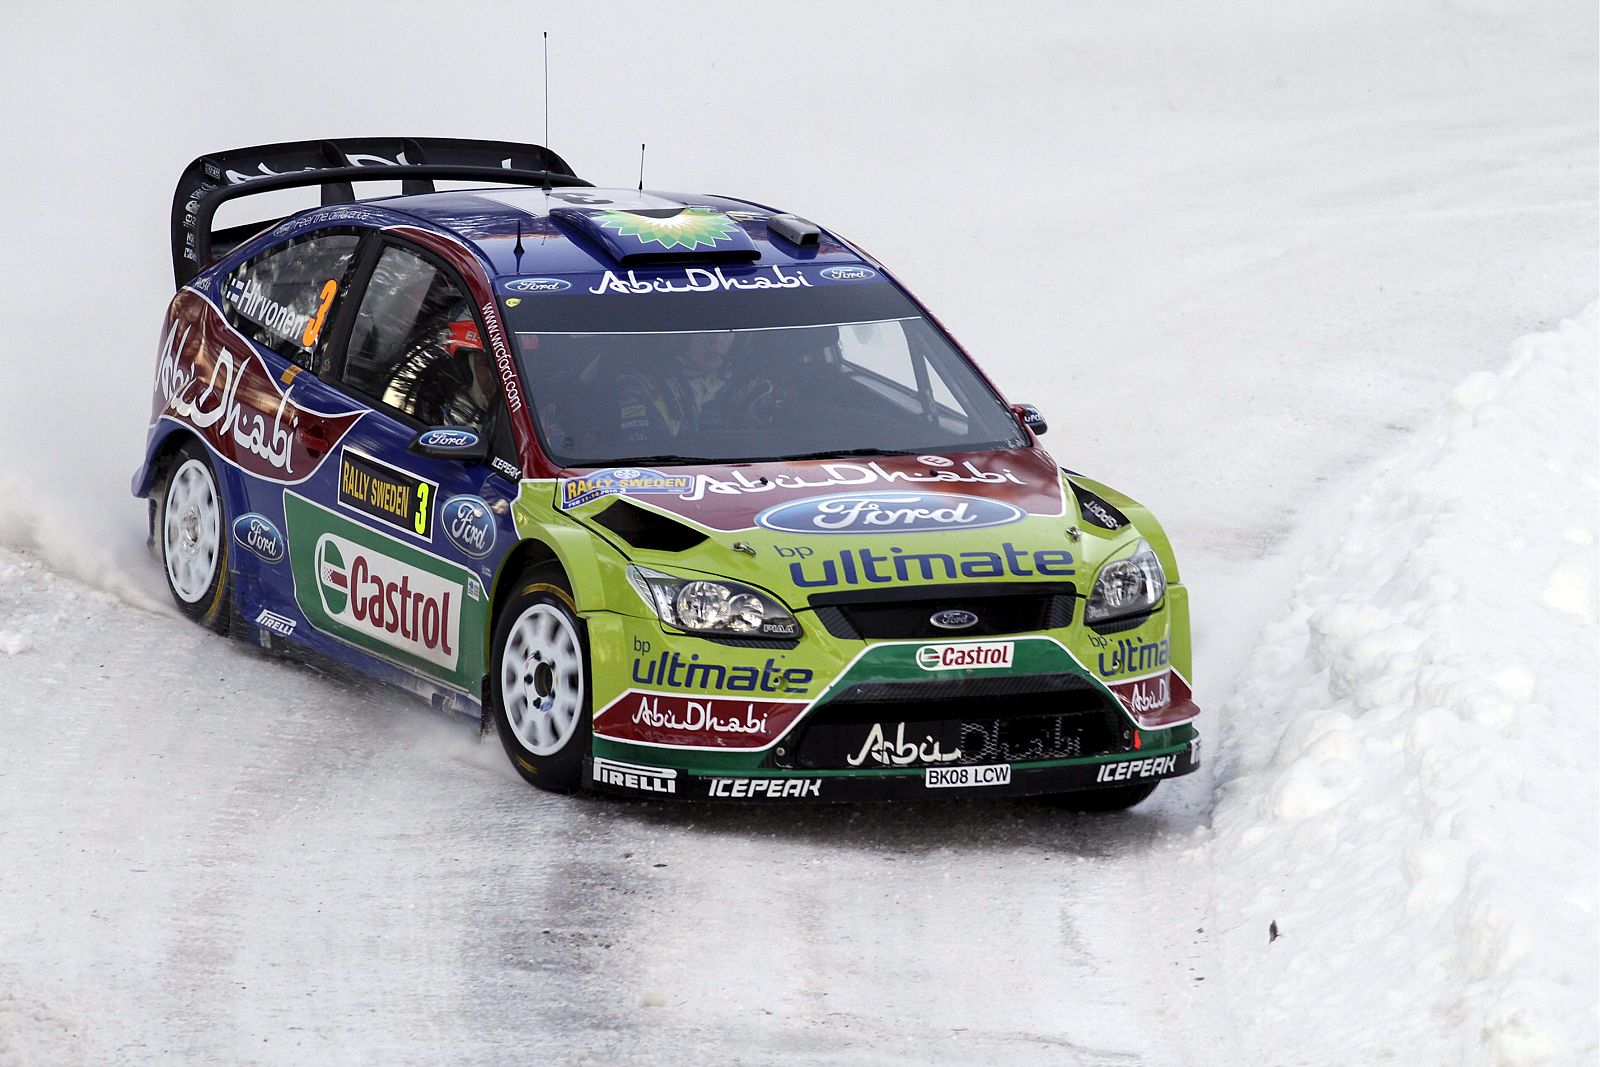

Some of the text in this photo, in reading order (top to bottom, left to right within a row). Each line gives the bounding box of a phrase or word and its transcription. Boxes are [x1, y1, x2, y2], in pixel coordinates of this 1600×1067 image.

[517, 280, 560, 291] Ford
[830, 268, 868, 280] Ford
[236, 279, 305, 341] Hirvonen
[302, 278, 338, 347] 3
[482, 302, 522, 413] www.wrcford.com
[428, 431, 468, 446] Ford
[491, 456, 522, 480] ICEPEAK
[342, 460, 410, 519] RALLY SWEDEN
[567, 477, 687, 500] RALLY SWEDEN
[414, 482, 430, 535] 3
[811, 496, 978, 530] Ford
[247, 519, 278, 557] Ford
[451, 502, 489, 550] Ford
[772, 543, 815, 560] bp
[789, 541, 1077, 588] ultimate
[350, 555, 452, 657] Castrol
[941, 612, 969, 625] Ford
[255, 608, 298, 637] PIRELLI
[634, 636, 650, 656] bp
[942, 645, 1009, 667] Castrol
[1088, 635, 1108, 649] bp
[631, 649, 814, 694] ultimate
[592, 756, 678, 794] PIRELLI
[928, 767, 1010, 786] BK08 LCW
[1096, 754, 1178, 784] ICEPEAK
[708, 777, 823, 798] ICEPEAK
